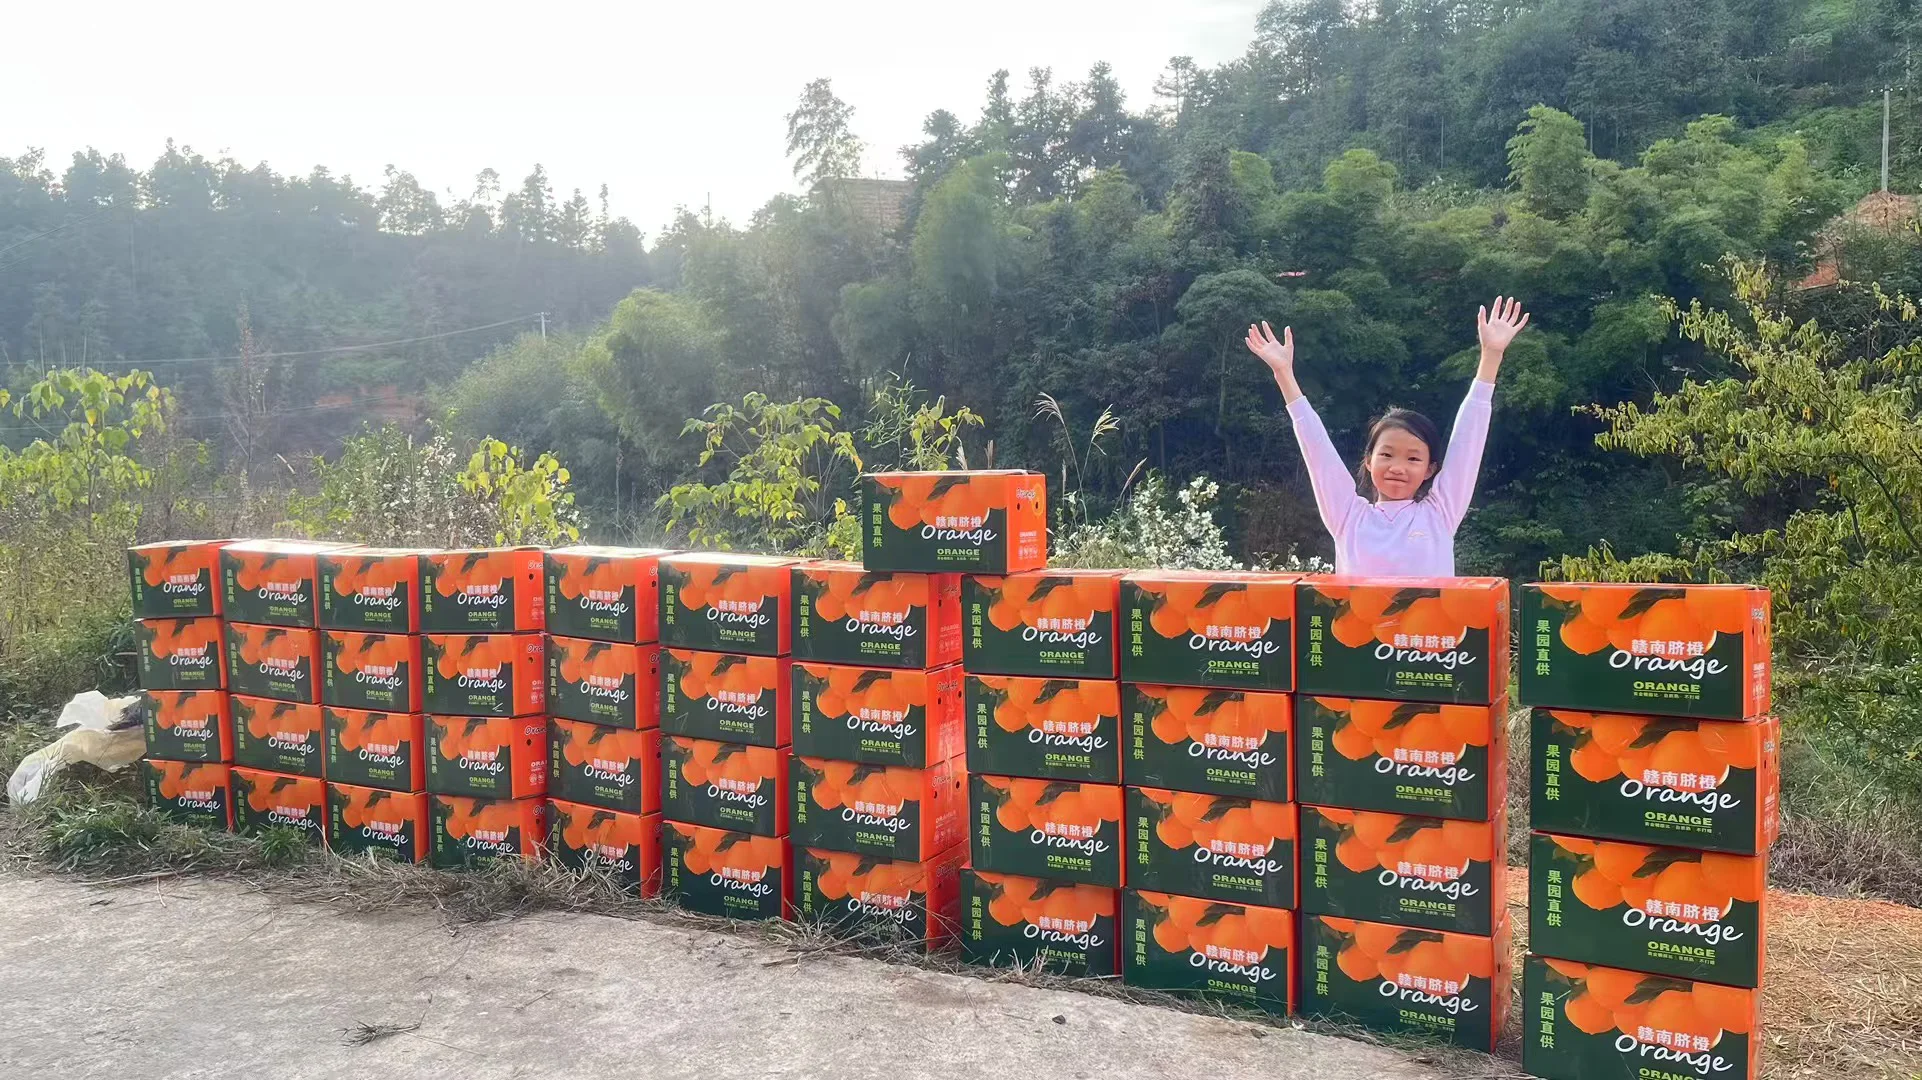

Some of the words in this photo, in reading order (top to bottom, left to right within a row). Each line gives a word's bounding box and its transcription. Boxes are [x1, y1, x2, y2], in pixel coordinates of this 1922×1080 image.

[872, 503, 883, 547] 果园直供
[936, 516, 982, 528] 赣南脐橙
[921, 524, 996, 545] Orange
[937, 548, 980, 556] ORANGE
[163, 582, 205, 596] Orange
[258, 588, 307, 606] Orange
[354, 593, 402, 610] Orange
[457, 592, 508, 609] Orange
[580, 596, 628, 617] Orange
[707, 607, 770, 629] Orange
[971, 603, 982, 648] 果园直供
[1037, 618, 1086, 630] 赣南脐橙
[720, 629, 756, 638] ORANGE
[846, 618, 917, 640] Orange
[1022, 626, 1102, 649] Orange
[1131, 608, 1143, 656] 果园直供
[1206, 625, 1261, 639] 赣南脐橙
[860, 641, 901, 650] ORANGE
[1189, 634, 1279, 658] Orange
[1310, 615, 1323, 667] 果园直供
[1394, 634, 1456, 649] 赣南脐橙
[1536, 619, 1551, 675] 果园直供
[1632, 640, 1703, 656] 赣南脐橙
[170, 654, 213, 669] Orange
[1039, 651, 1084, 659] ORANGE
[1208, 660, 1259, 669] ORANGE
[1375, 643, 1475, 670] Orange
[1609, 650, 1727, 679] Orange
[259, 662, 304, 682] Orange
[356, 671, 403, 690] Orange
[1395, 671, 1453, 681] ORANGE
[458, 675, 506, 693] Orange
[580, 681, 629, 703] Orange
[1633, 681, 1700, 693] ORANGE
[706, 697, 768, 720] Orange
[174, 725, 213, 741] Orange
[719, 719, 754, 729] ORANGE
[847, 715, 916, 739] Orange
[977, 703, 988, 748] 果园直供
[1043, 720, 1092, 734] 赣南脐橙
[268, 736, 315, 756] Orange
[861, 739, 901, 749] ORANGE
[1028, 728, 1107, 753] Orange
[1133, 713, 1144, 760] 果园直供
[1205, 733, 1258, 750] 赣南脐橙
[359, 749, 404, 768] Orange
[1045, 753, 1090, 763] ORANGE
[1188, 741, 1275, 769] Orange
[1311, 726, 1324, 777] 果园直供
[1394, 748, 1455, 765] 赣南脐橙
[459, 757, 504, 776] Orange
[584, 764, 634, 787] Orange
[1206, 768, 1256, 780] ORANGE
[1375, 757, 1474, 786] Orange
[1545, 744, 1560, 801] 果园直供
[1643, 770, 1716, 790] 赣南脐橙
[707, 784, 767, 809] Orange
[1395, 785, 1452, 797] ORANGE
[1620, 779, 1740, 813] Orange
[178, 796, 220, 813] Orange
[720, 807, 754, 818] ORANGE
[842, 808, 910, 833] Orange
[980, 802, 991, 847] 果园直供
[1645, 811, 1712, 826] ORANGE
[362, 826, 408, 847] Orange
[856, 831, 895, 842] ORANGE
[1045, 822, 1093, 838] 赣南脐橙
[1030, 829, 1108, 856] Orange
[1137, 817, 1149, 864] 果园直供
[1211, 839, 1265, 857] 赣南脐橙
[1047, 855, 1092, 866] ORANGE
[1194, 847, 1282, 876] Orange
[1314, 838, 1328, 888] 果园直供
[1212, 874, 1263, 887] ORANGE
[1398, 862, 1458, 880] 赣南脐橙
[710, 873, 773, 897] Orange
[1379, 870, 1478, 900] Orange
[723, 895, 759, 906] ORANGE
[1399, 898, 1456, 911] ORANGE
[1547, 870, 1562, 927] 果园直供
[971, 896, 982, 940] 果园直供
[1646, 899, 1719, 922] 赣南脐橙
[1039, 916, 1088, 932] 赣南脐橙
[1623, 908, 1742, 945] Orange
[1024, 924, 1104, 950] Orange
[1135, 919, 1146, 966] 果园直供
[1206, 945, 1259, 964] 赣南脐橙
[1648, 941, 1715, 958] ORANGE
[1190, 952, 1276, 983] Orange
[1316, 945, 1329, 995] 果园直供
[1207, 979, 1256, 994] ORANGE
[1398, 973, 1458, 994] 赣南脐橙
[1379, 981, 1478, 1014] Orange
[1399, 1010, 1455, 1026] ORANGE
[1540, 992, 1555, 1049] 果园直供
[1638, 1026, 1709, 1052] 赣南脐橙
[1615, 1034, 1732, 1074] Orange
